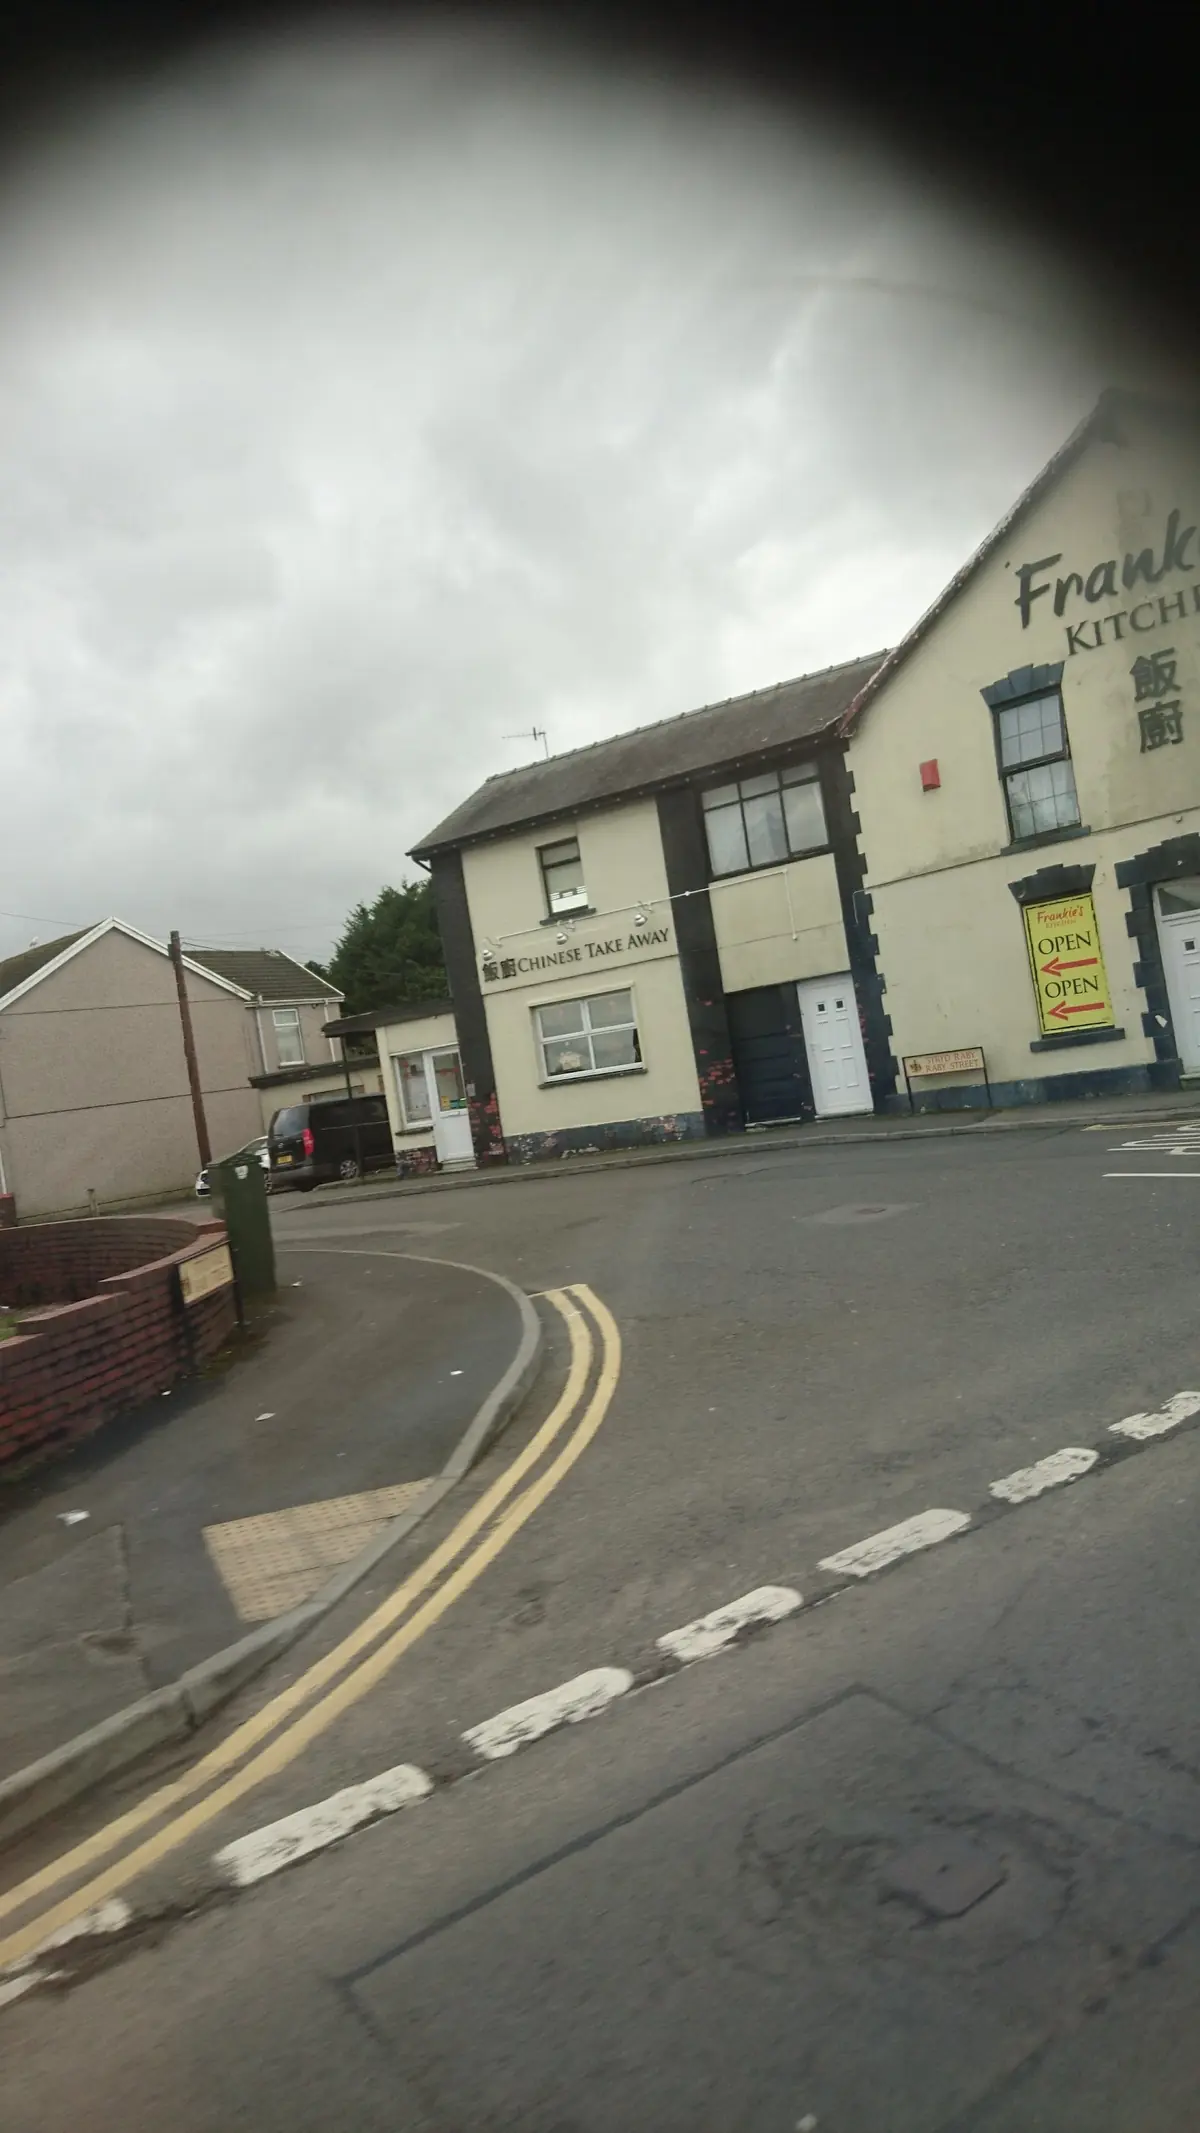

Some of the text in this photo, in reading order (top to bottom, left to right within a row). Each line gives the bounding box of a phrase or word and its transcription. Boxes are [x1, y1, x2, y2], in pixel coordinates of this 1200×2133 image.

[1014, 508, 1200, 630] Frank
[1038, 930, 1092, 955] OPEN
[1044, 975, 1099, 999] OPEN
